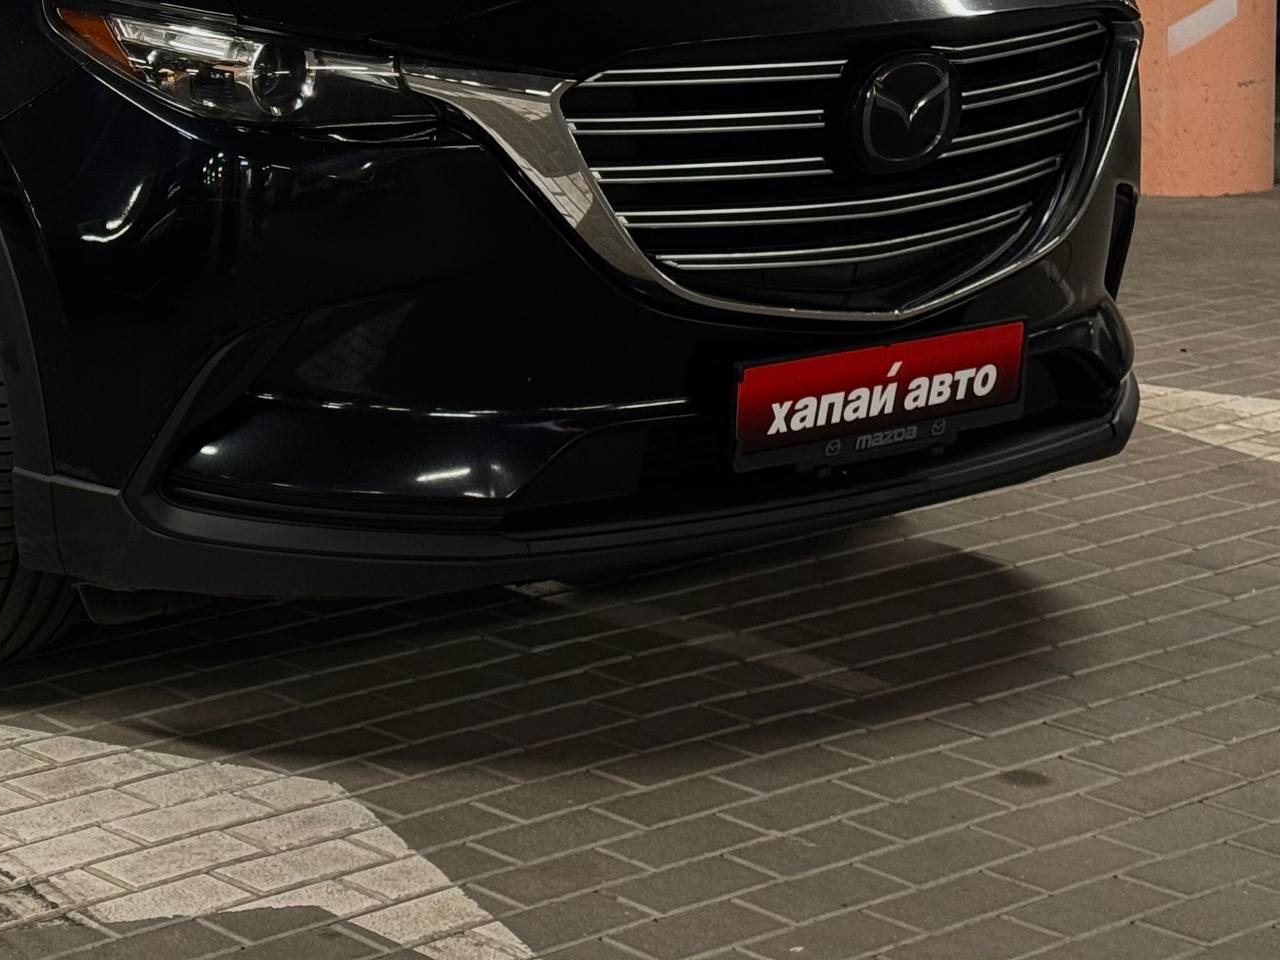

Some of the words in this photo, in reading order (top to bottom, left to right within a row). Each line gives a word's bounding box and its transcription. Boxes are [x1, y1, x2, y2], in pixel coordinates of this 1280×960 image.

[767, 361, 904, 436] хапай
[904, 363, 998, 411] авто
[855, 425, 918, 451] mazda
